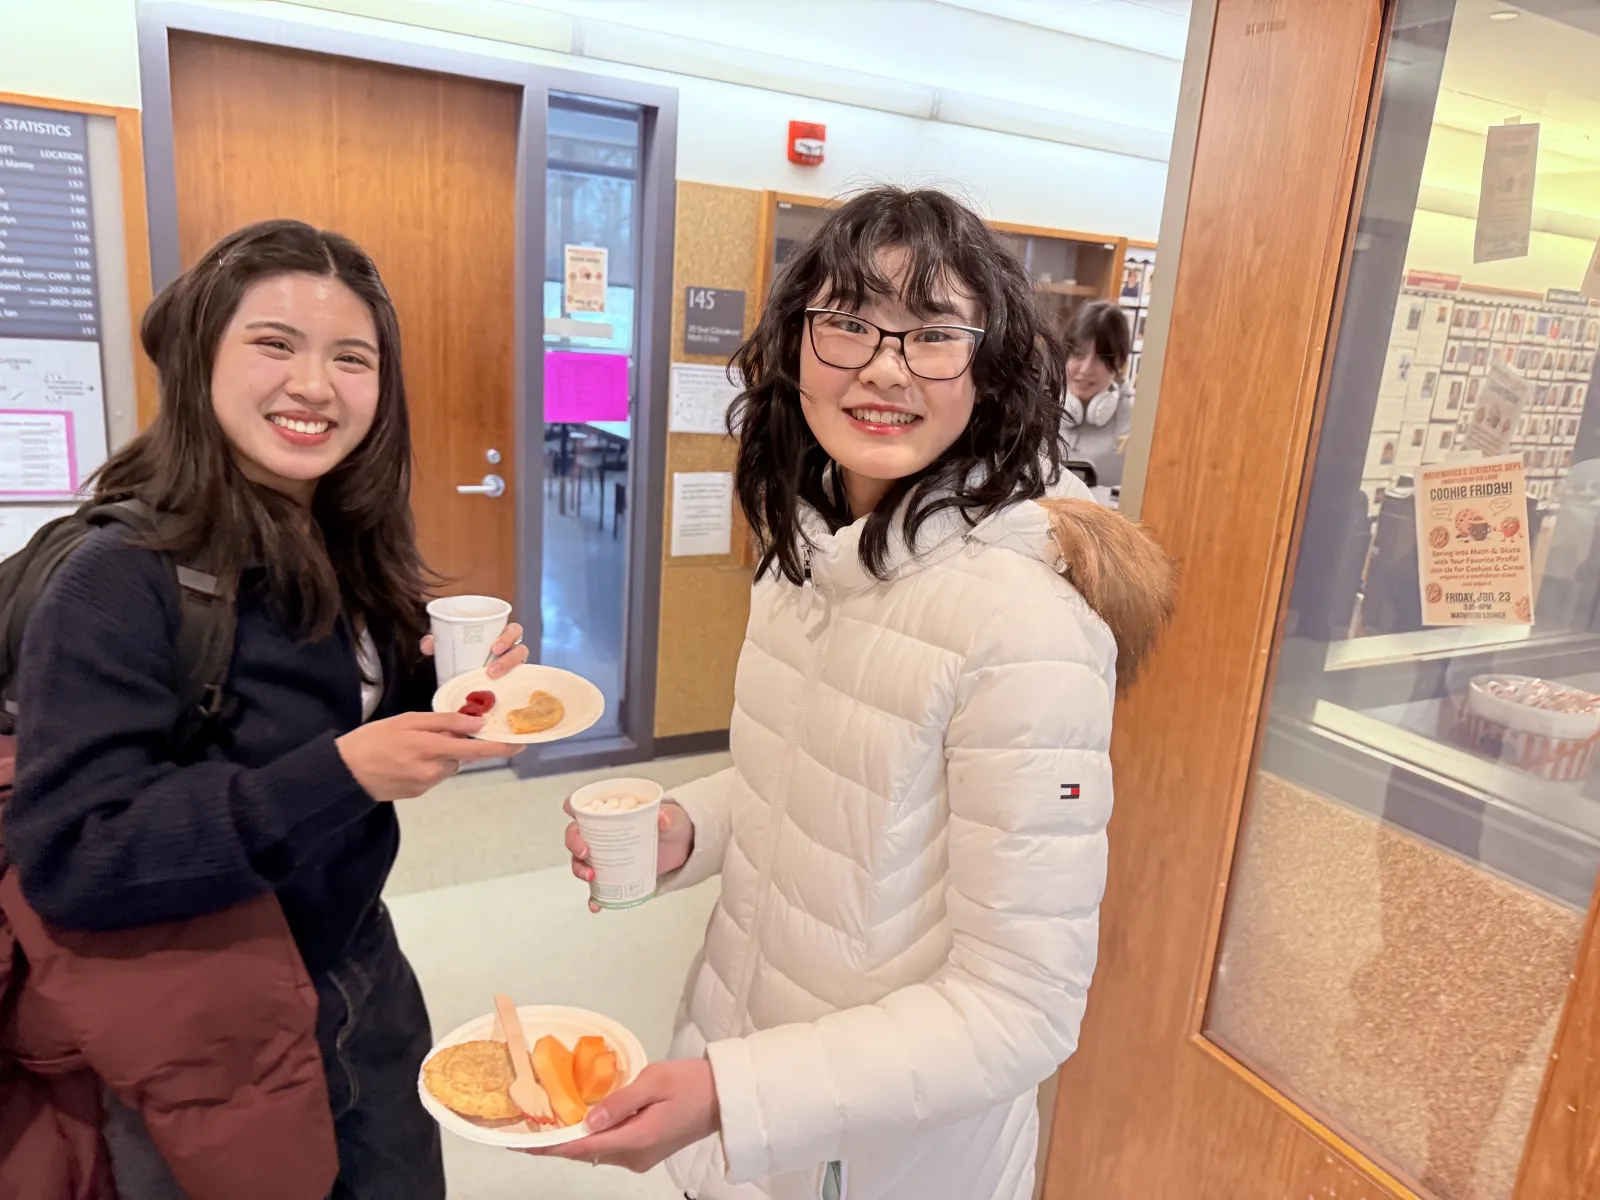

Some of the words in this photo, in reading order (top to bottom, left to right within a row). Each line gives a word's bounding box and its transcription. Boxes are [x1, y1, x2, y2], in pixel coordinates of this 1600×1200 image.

[4, 118, 72, 137] STATISTICS
[40, 148, 83, 162] LOCATION
[689, 288, 716, 310] 145
[1469, 464, 1503, 475] STATISTICS
[1466, 556, 1494, 564] Favorite
[1466, 565, 1492, 573] Cookies
[1499, 592, 1511, 602] 23
